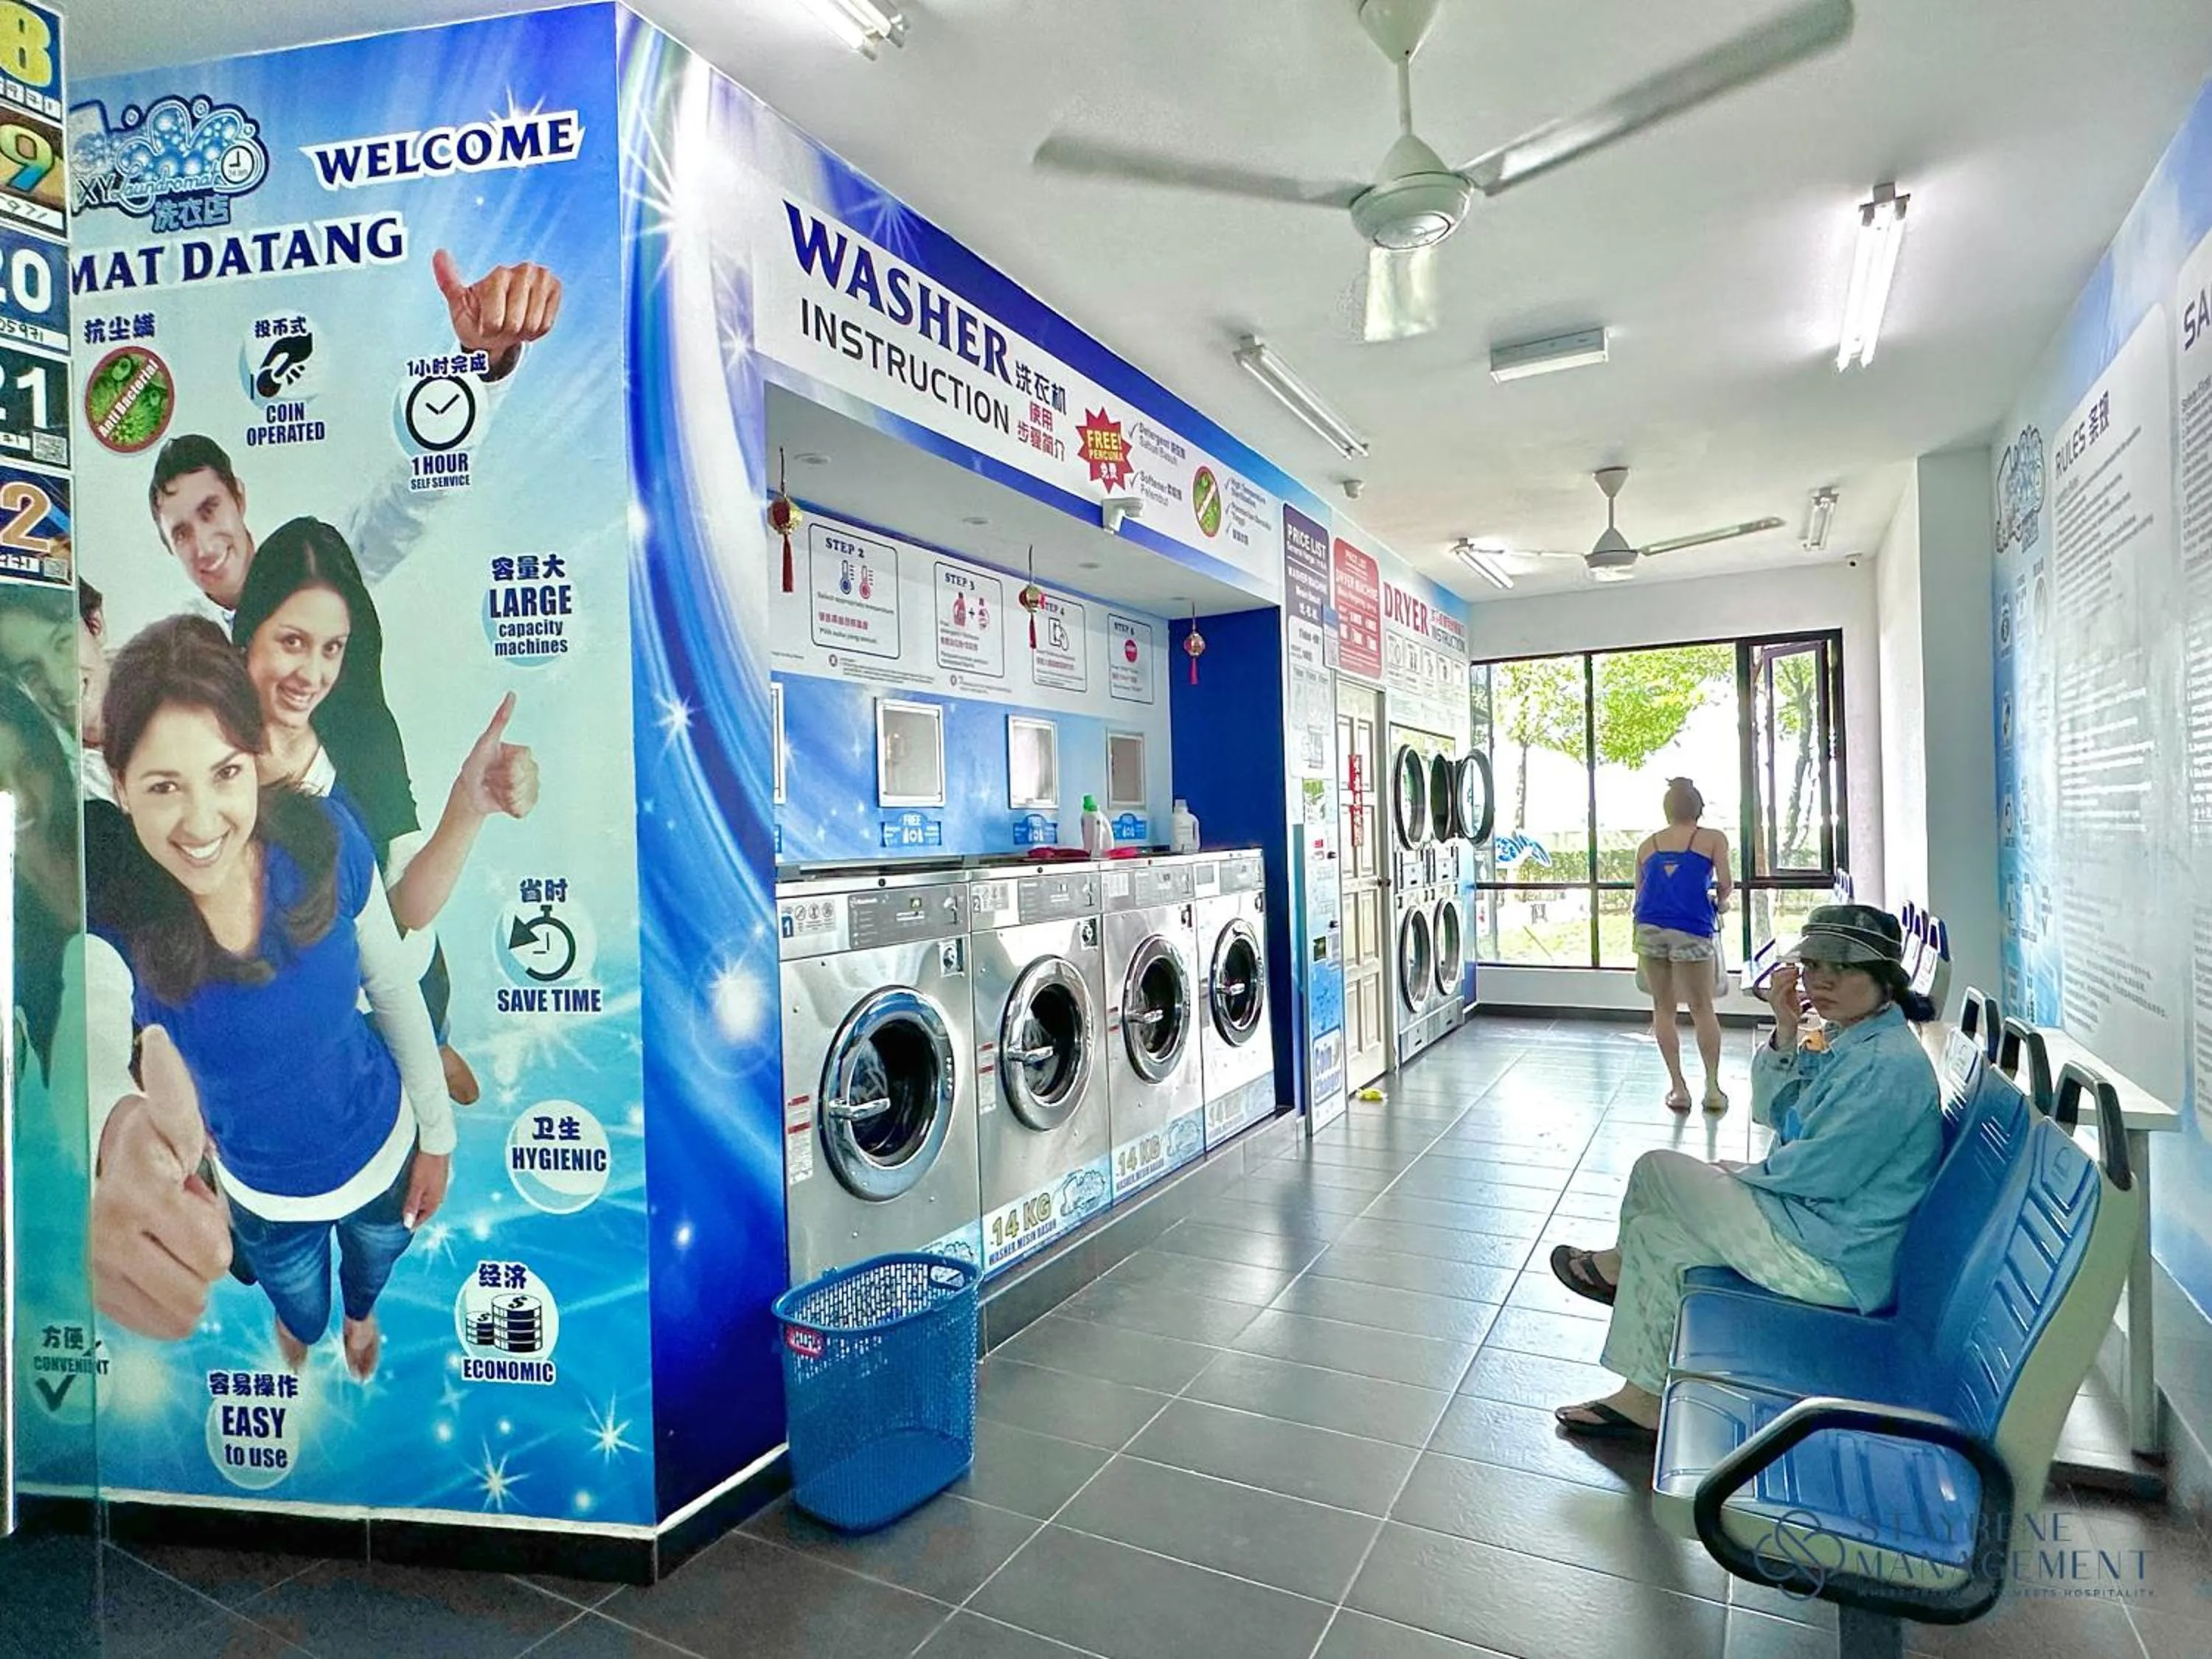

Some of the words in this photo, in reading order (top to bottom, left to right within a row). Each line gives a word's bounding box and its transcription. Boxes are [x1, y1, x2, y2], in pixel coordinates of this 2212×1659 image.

[316, 116, 576, 180] WELCOME
[72, 173, 116, 213] XY
[153, 195, 231, 232] 洗衣店
[183, 218, 403, 282] DATANG
[0, 247, 52, 314] 0
[782, 198, 1013, 386] WASHER
[83, 313, 156, 344] 抗尘螨
[254, 316, 308, 338] 投币式
[2183, 282, 2212, 352] SA
[406, 353, 489, 378] 1小时完成
[800, 296, 1010, 435] INSTRUCTION
[0, 366, 47, 430] 1
[98, 410, 121, 438] Anti
[116, 358, 160, 411] Bacterial
[1015, 360, 1068, 417] 洗衣机
[266, 403, 305, 424] COIN
[1029, 400, 1054, 432] 使用
[246, 421, 326, 447] OPERATED
[1018, 420, 1066, 462] 步骤简介
[1087, 428, 1123, 451] FREE!
[411, 456, 420, 476] 1
[423, 453, 469, 475] HOUR
[1088, 448, 1124, 463] PERCUMA
[2056, 422, 2086, 480] RULES
[411, 477, 431, 490] SELF
[431, 474, 470, 489] SERVICE
[825, 537, 855, 556] STEP
[858, 548, 866, 559] 2
[1287, 523, 1311, 552] PRICE
[1311, 535, 1326, 560] LIST
[491, 554, 566, 582] 容量大
[945, 572, 968, 588] STEP
[489, 585, 573, 619] LARGE
[1383, 581, 1430, 637] DRYER
[499, 620, 564, 639] capacity
[495, 639, 568, 657] machines
[520, 878, 568, 903] 省时
[497, 990, 548, 1013] SAVE
[552, 990, 602, 1013] TIME
[532, 1116, 582, 1141] 卫生
[512, 1147, 607, 1172] HYGIENIC
[992, 1213, 1020, 1248] 14
[1023, 1192, 1051, 1232] KG
[479, 1263, 528, 1290] 经济
[42, 1324, 85, 1351] 方便
[463, 1358, 554, 1383] ECONOMIC
[209, 1371, 299, 1399] 容易操作
[222, 1405, 287, 1439] EASY
[225, 1443, 246, 1467] to
[250, 1447, 288, 1469] use
